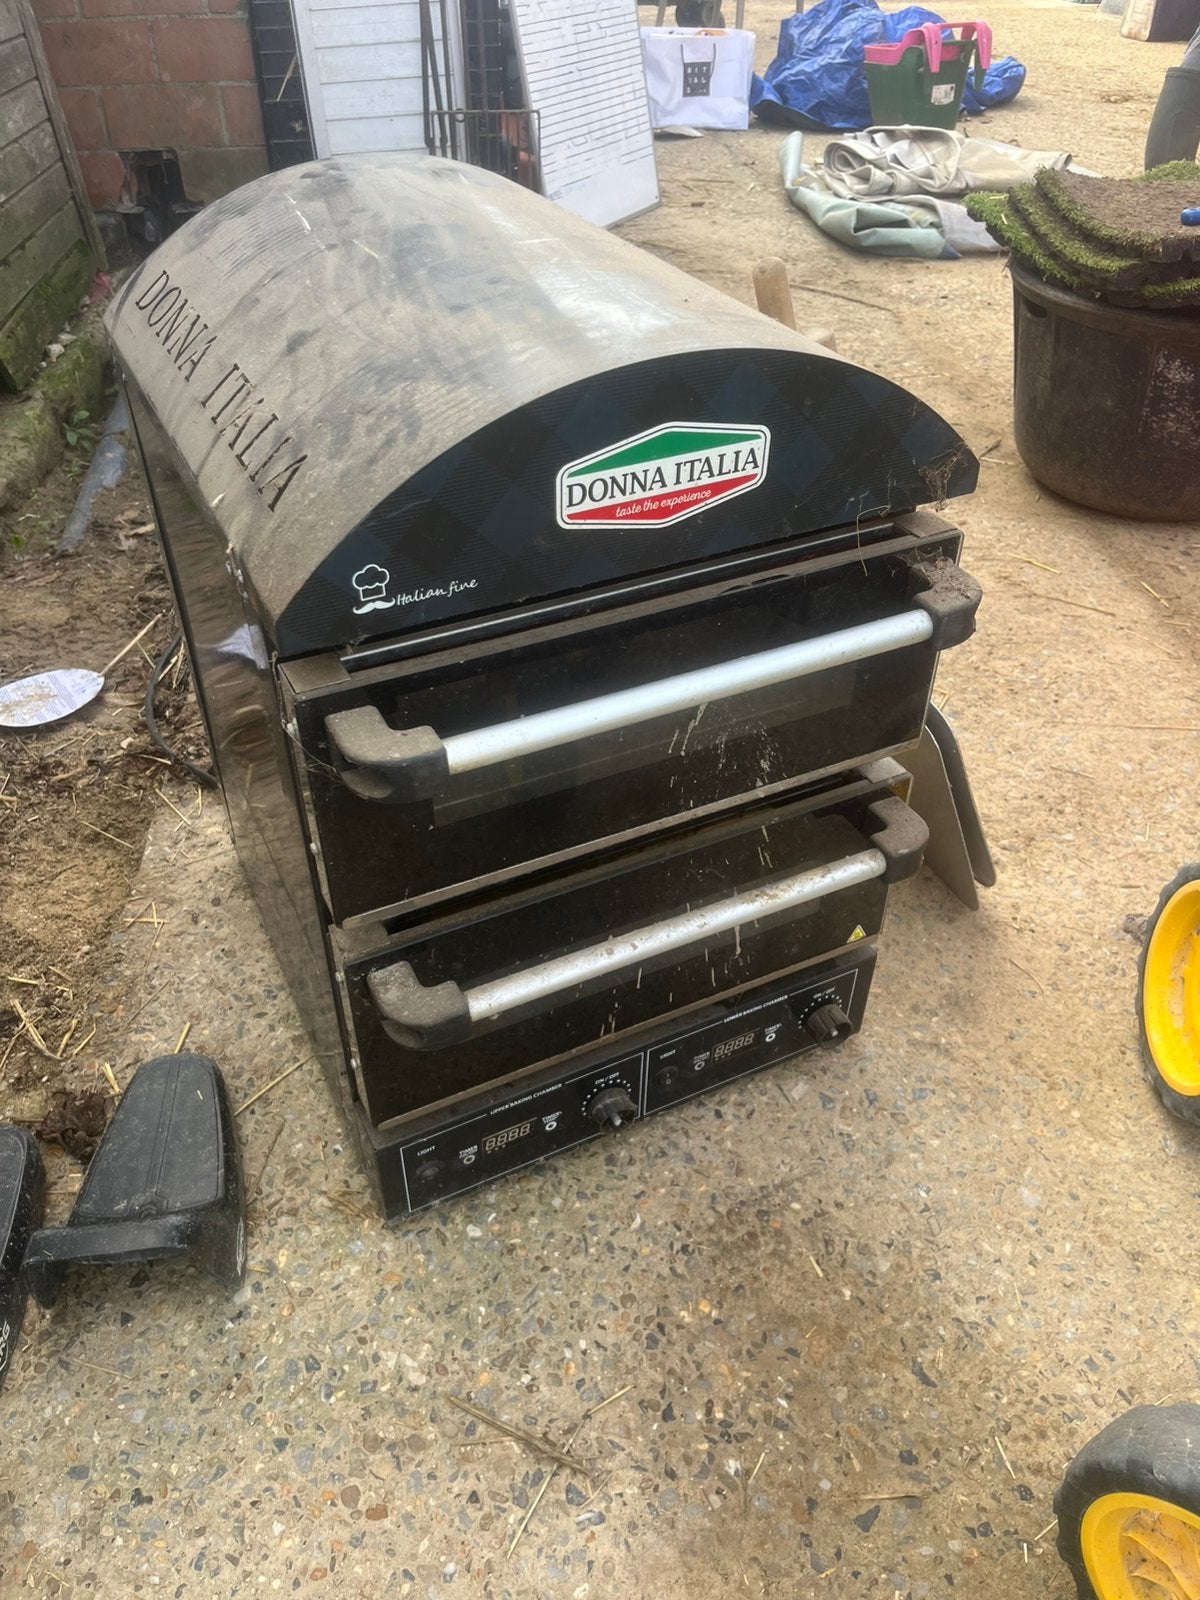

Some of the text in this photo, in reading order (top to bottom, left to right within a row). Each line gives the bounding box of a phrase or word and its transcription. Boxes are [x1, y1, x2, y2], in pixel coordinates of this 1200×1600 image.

[135, 270, 308, 512] DONNA ITALIA
[566, 447, 760, 508] DONNA ITALIA
[615, 489, 712, 518] taste the experience
[397, 579, 479, 606] Italian fine
[490, 1083, 562, 1115] UPPER BAKING CHAMBER
[417, 1145, 436, 1156] LIGHT
